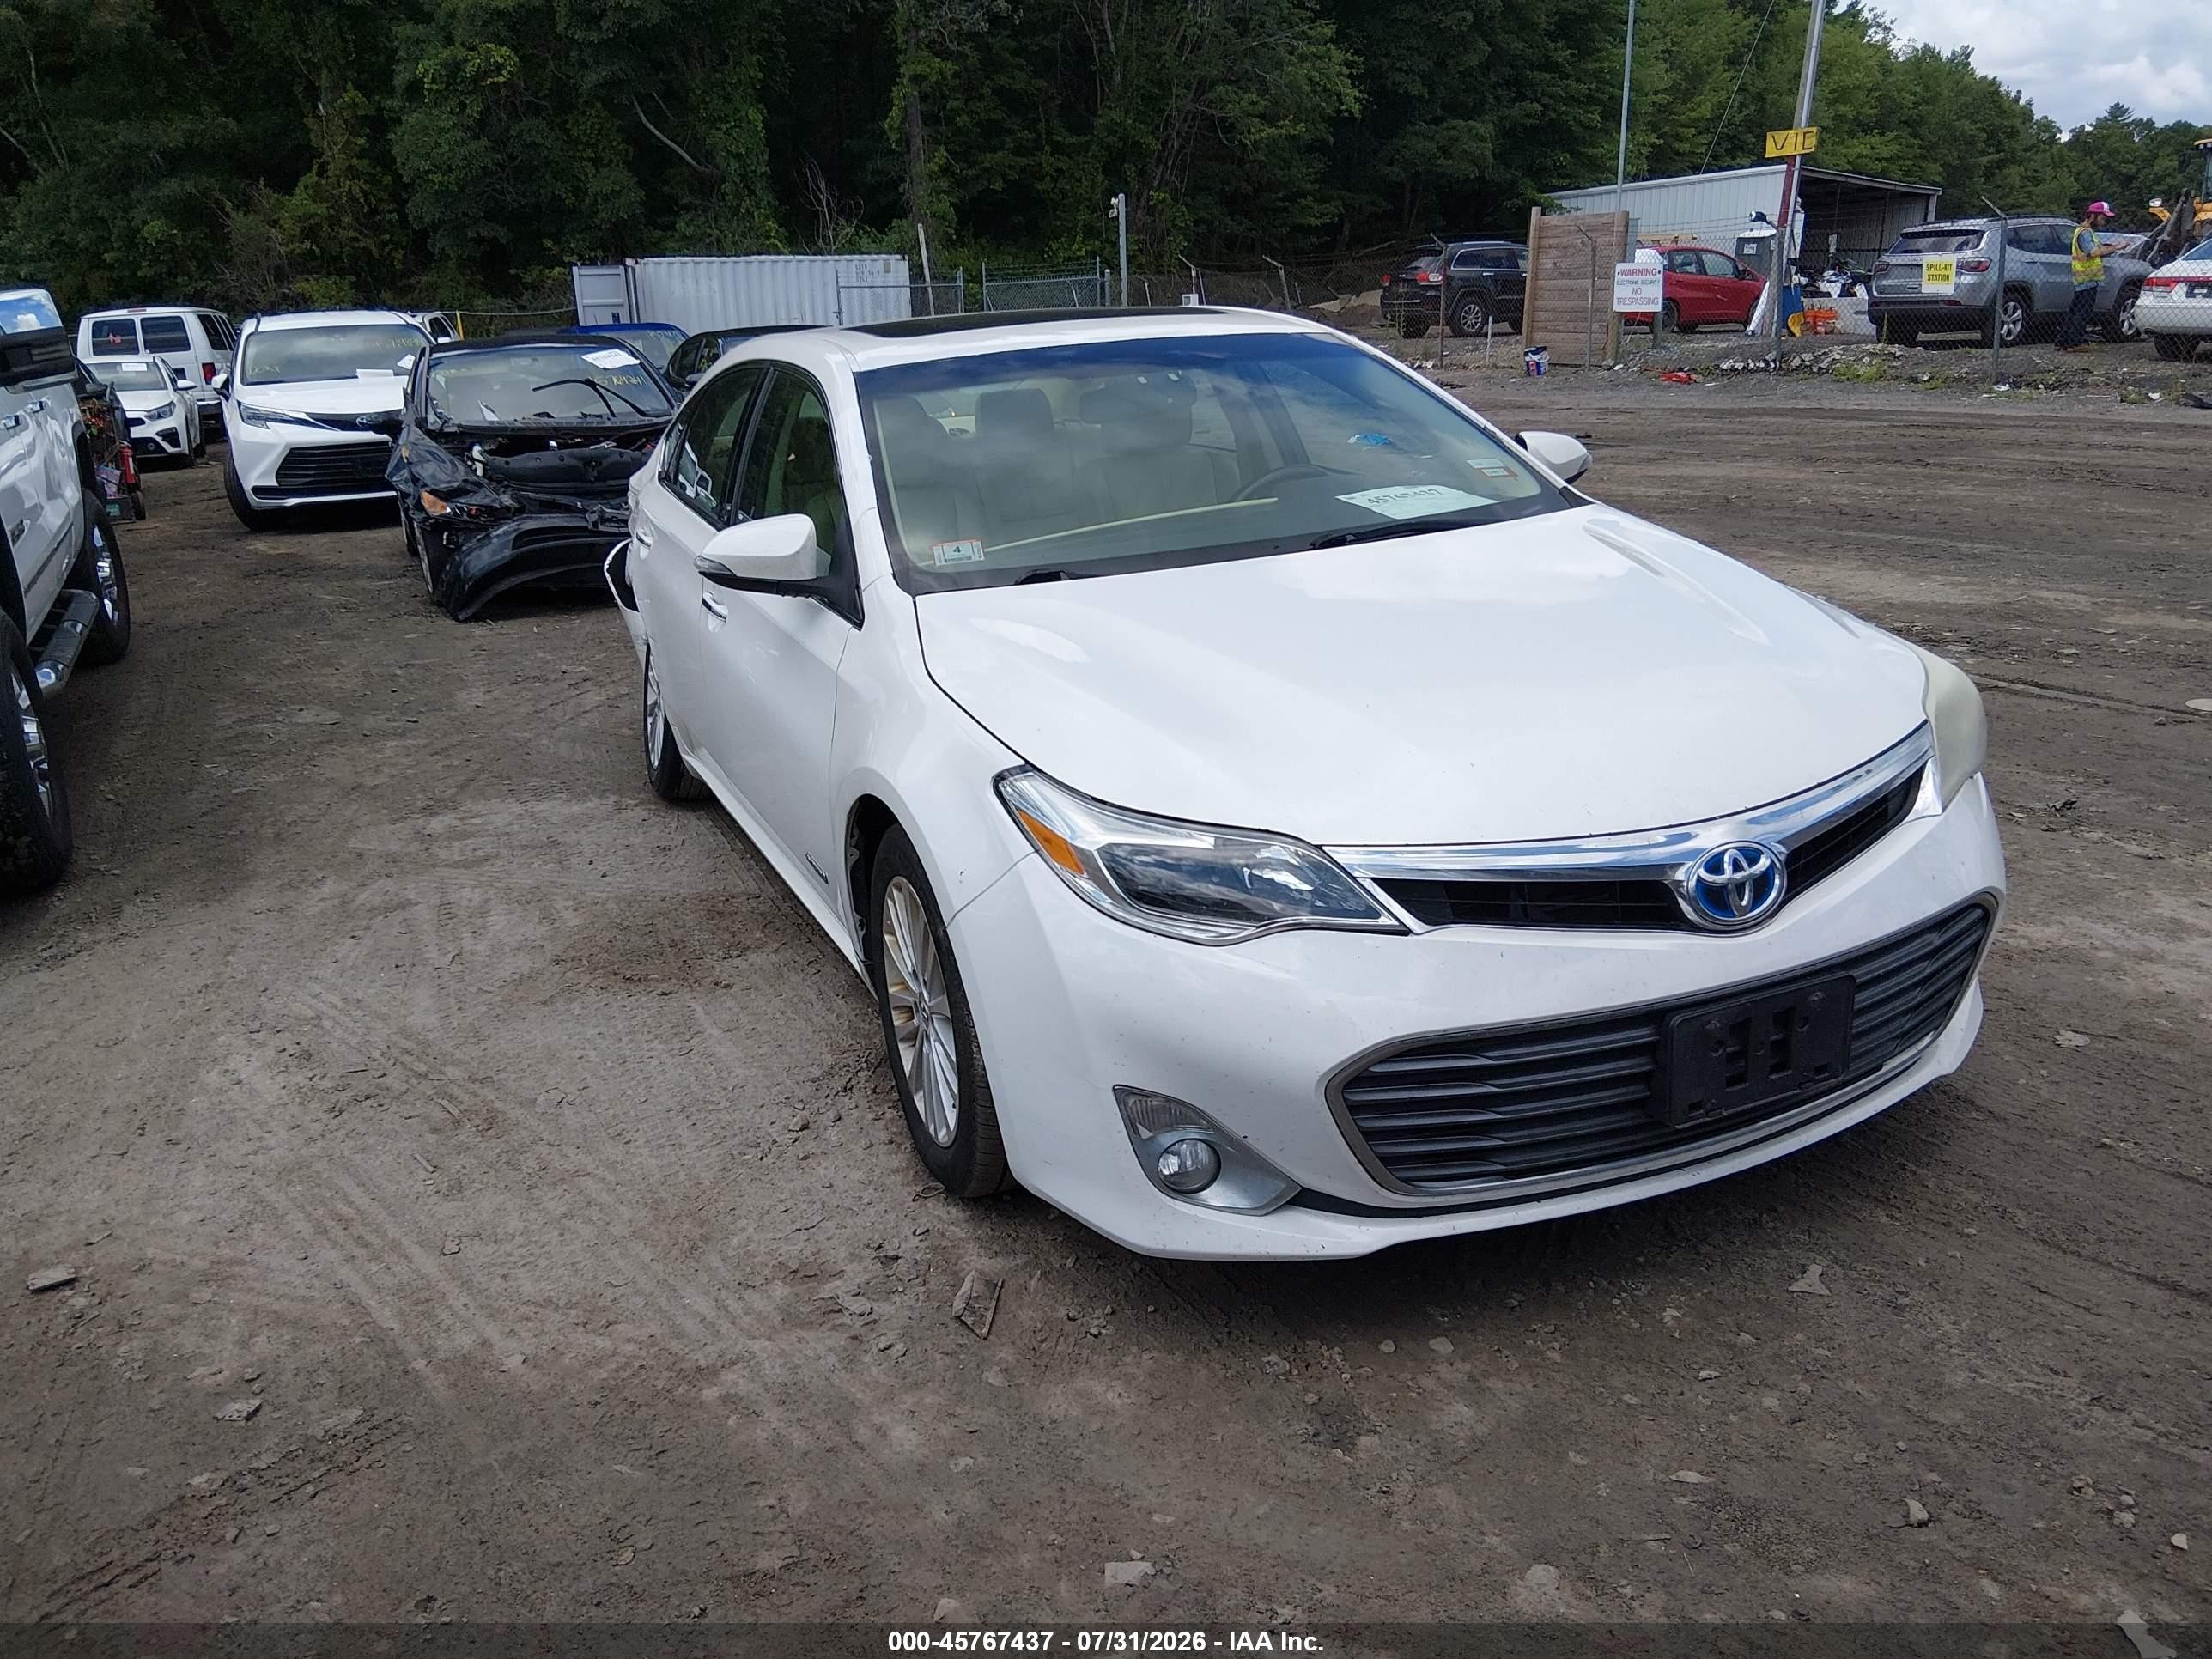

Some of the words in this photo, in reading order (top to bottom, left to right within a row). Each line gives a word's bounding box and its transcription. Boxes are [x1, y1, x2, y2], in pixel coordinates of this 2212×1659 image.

[1620, 268, 1657, 276] WARNING
[1925, 263, 1953, 272] SPILL-KIT
[1927, 274, 1950, 283] STATION
[1632, 287, 1643, 296] NO
[1615, 296, 1659, 306] TRESPASSING
